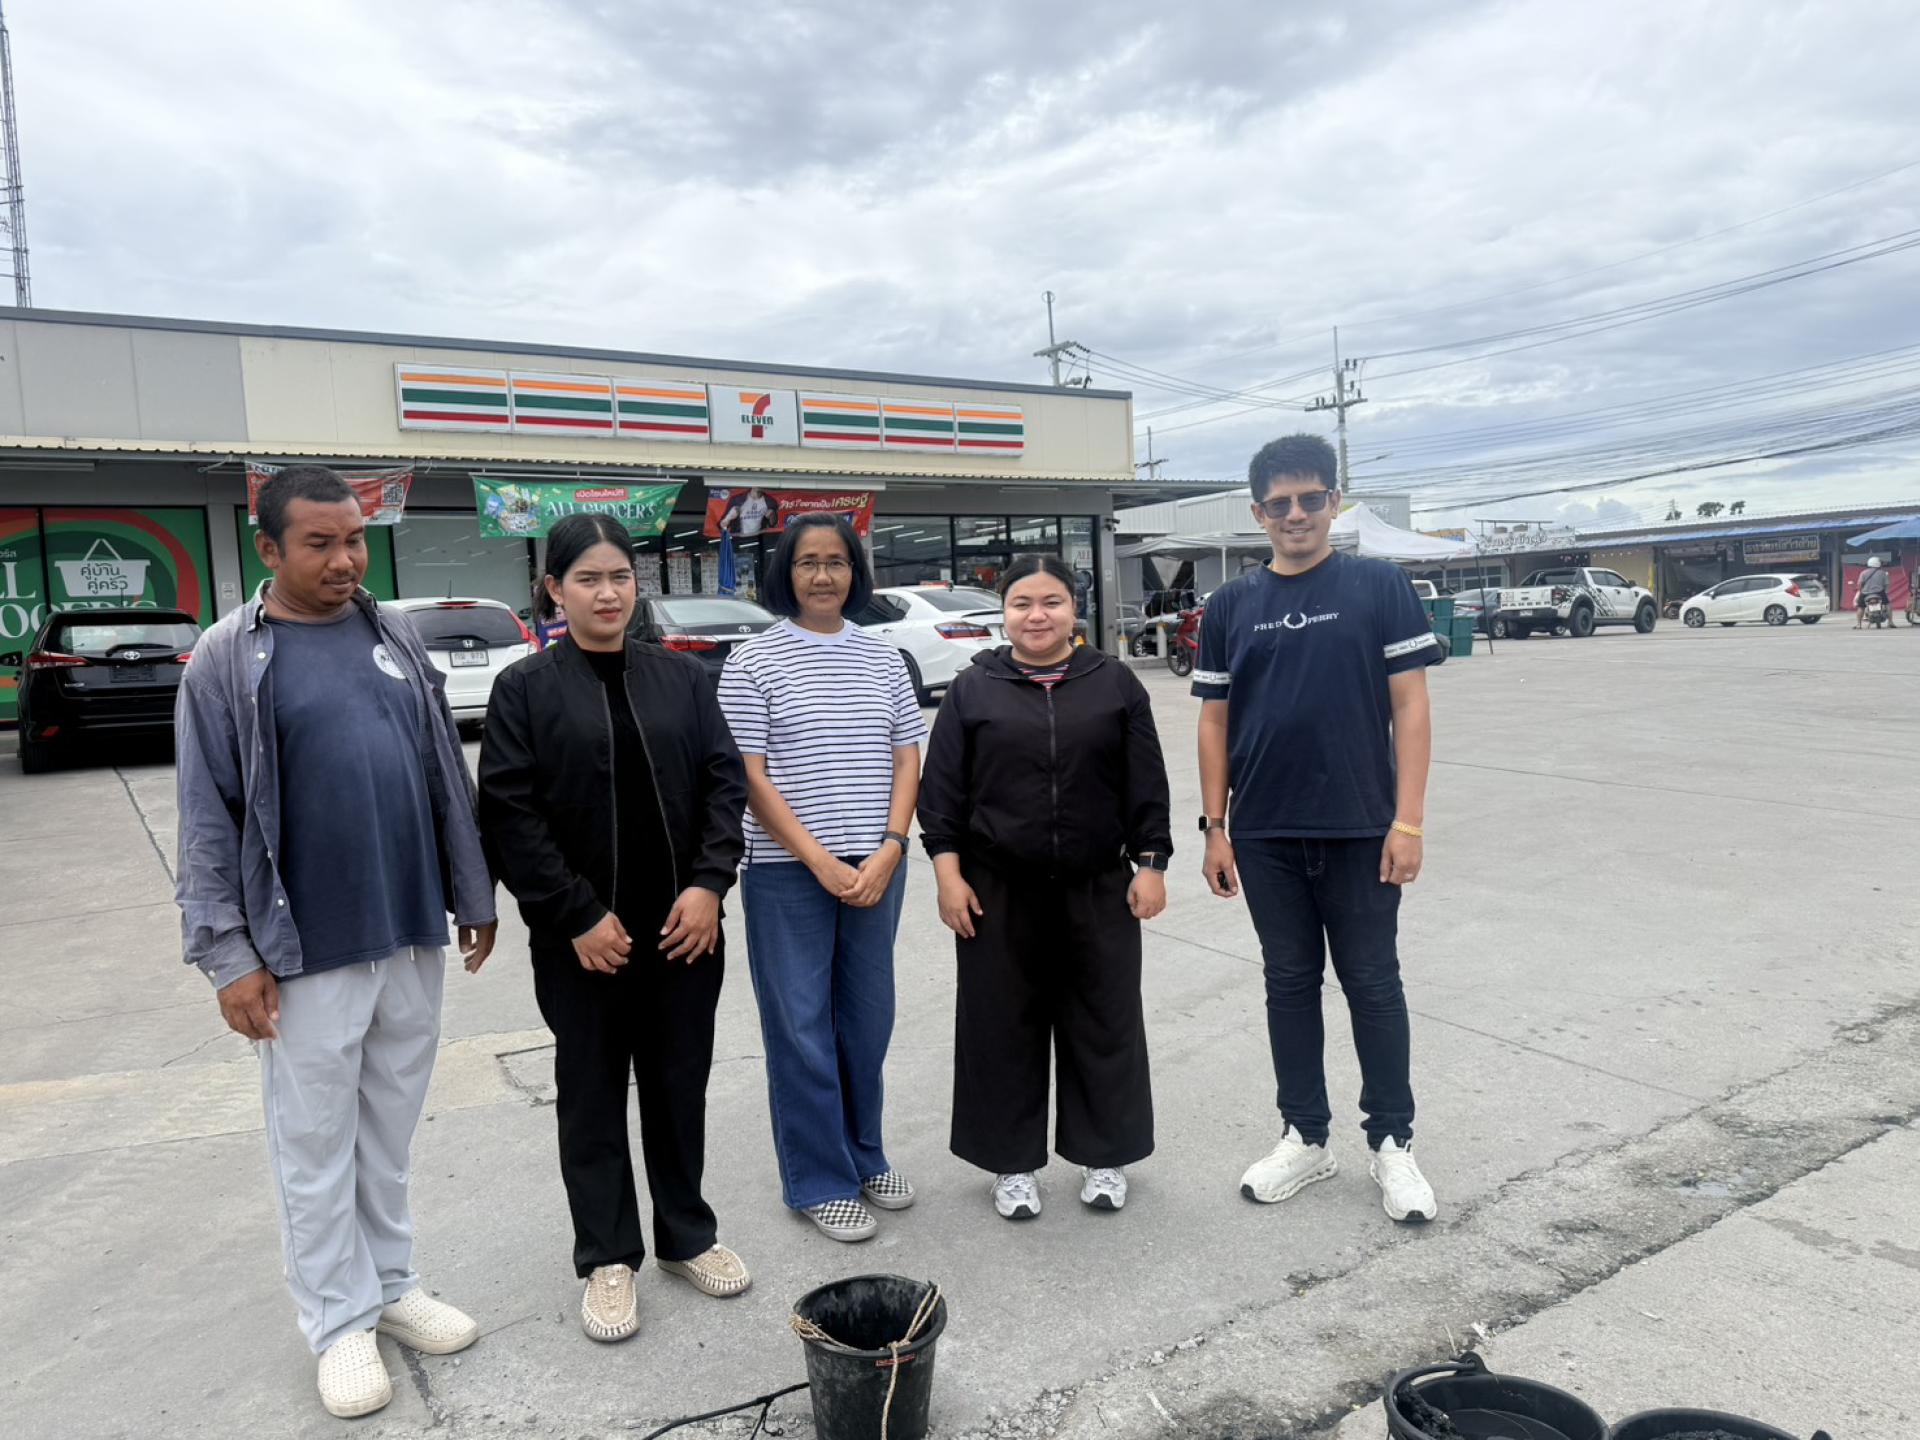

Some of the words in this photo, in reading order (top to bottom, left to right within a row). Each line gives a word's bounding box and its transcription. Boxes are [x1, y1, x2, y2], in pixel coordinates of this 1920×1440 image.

[739, 392, 771, 438] 7
[81, 563, 120, 580] คู่บ้าน
[87, 575, 128, 594] คู่ครัว
[1254, 621, 1282, 631] FRED
